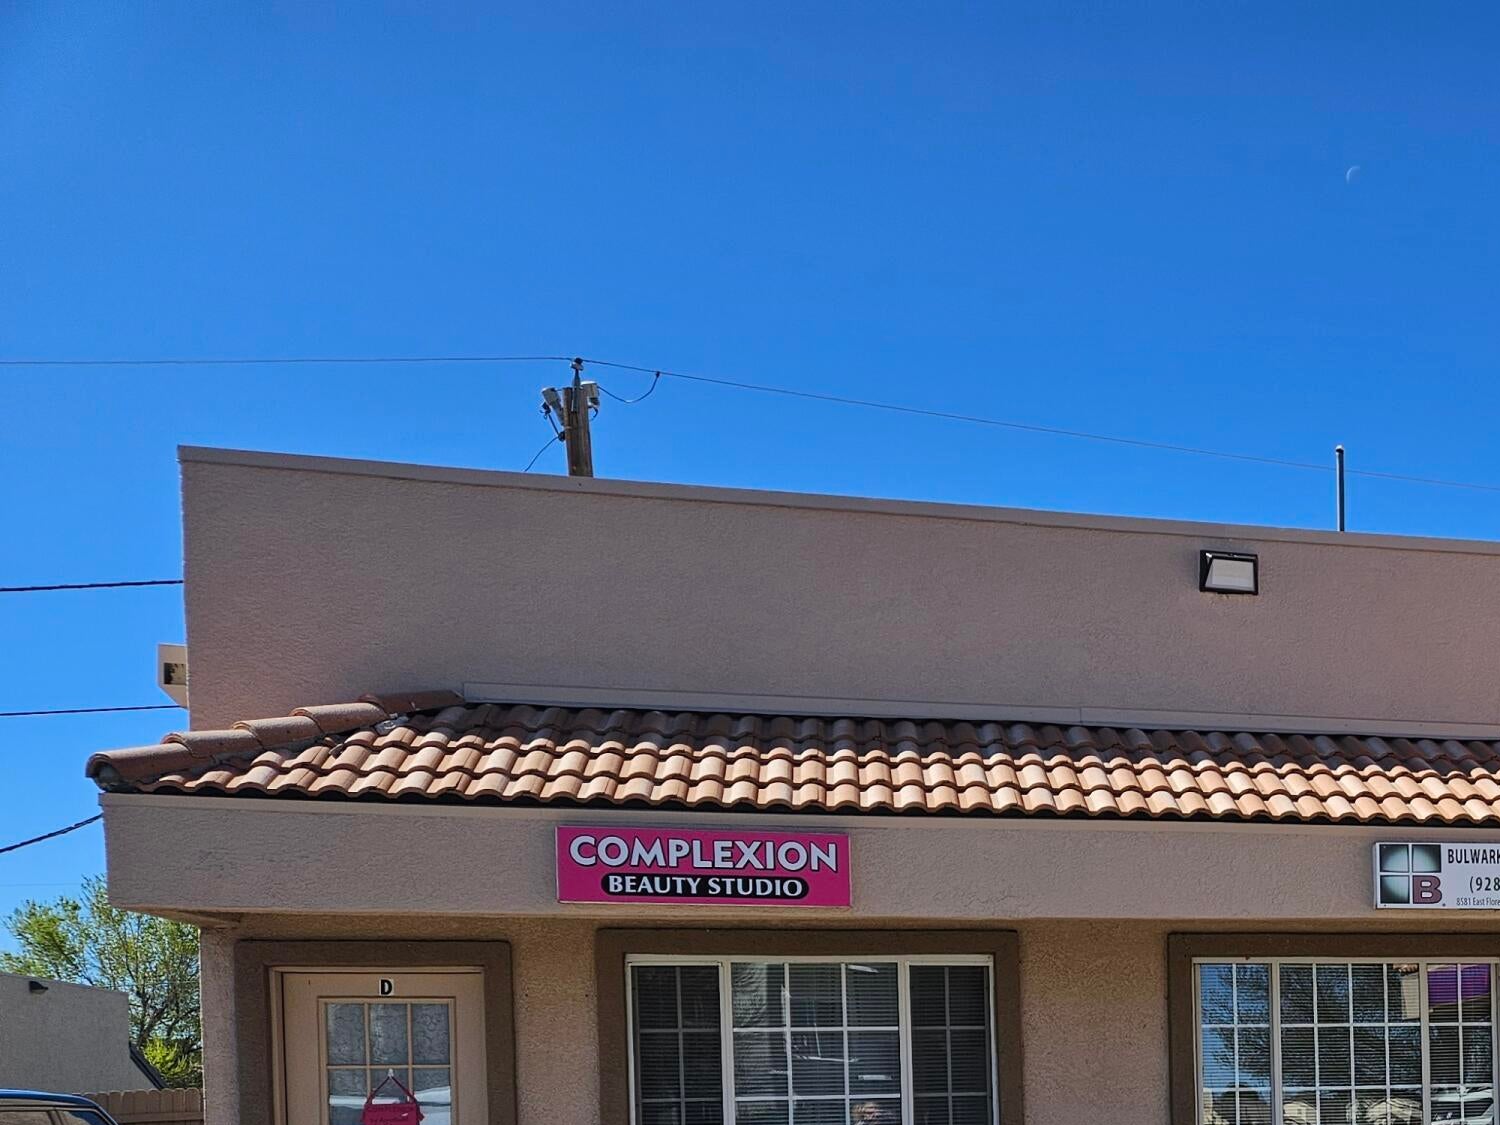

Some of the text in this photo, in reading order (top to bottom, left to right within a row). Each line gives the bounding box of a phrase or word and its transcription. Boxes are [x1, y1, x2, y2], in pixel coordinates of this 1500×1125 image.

[569, 834, 838, 872] COMPLEXION
[608, 875, 802, 897] BEAUTY STUDIO
[1412, 875, 1443, 904] B
[1456, 897, 1471, 906] 8581
[1472, 897, 1485, 906] East
[380, 979, 393, 995] D
